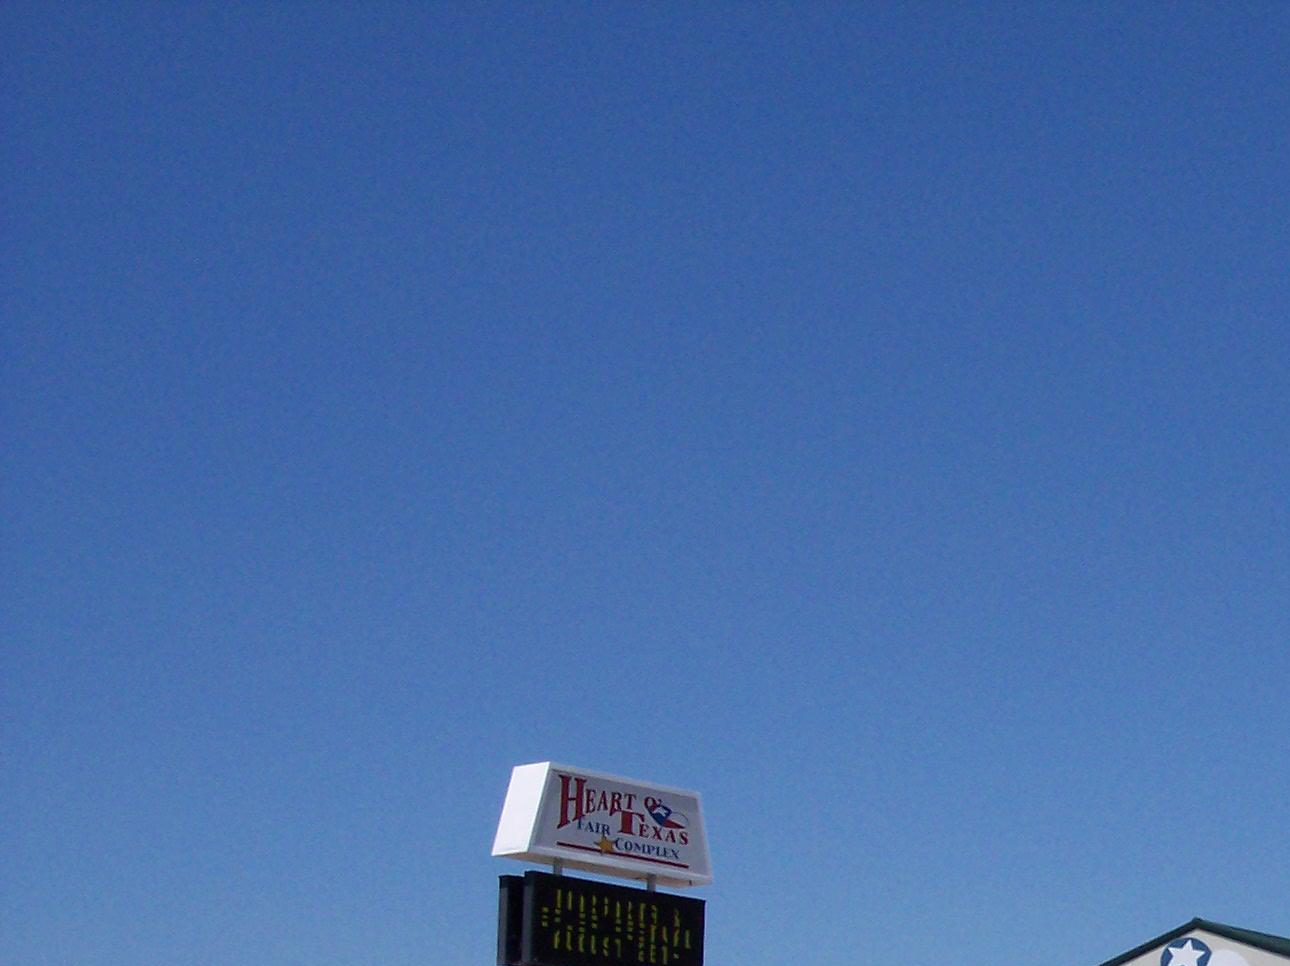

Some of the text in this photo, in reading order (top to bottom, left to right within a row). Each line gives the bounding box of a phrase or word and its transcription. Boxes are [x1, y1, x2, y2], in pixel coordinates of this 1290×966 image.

[556, 774, 637, 830] HEART
[577, 818, 611, 836] FAIR
[609, 809, 689, 845] TEXAS
[614, 837, 680, 859] COMPLEX
